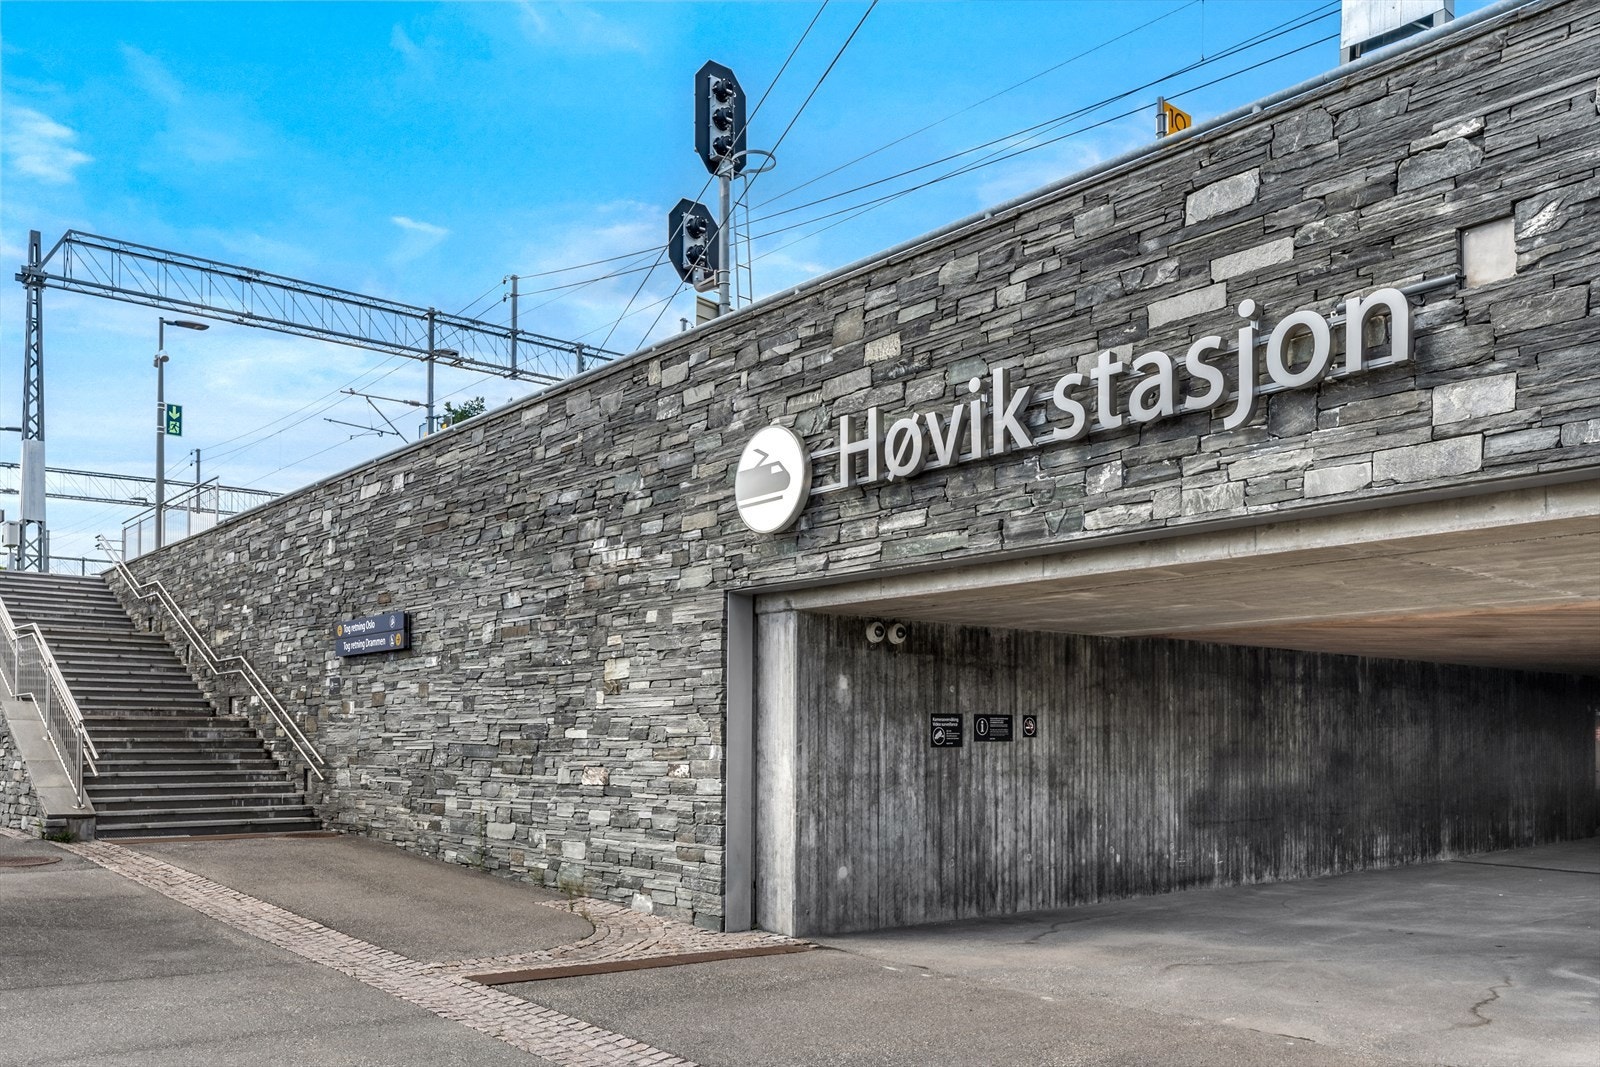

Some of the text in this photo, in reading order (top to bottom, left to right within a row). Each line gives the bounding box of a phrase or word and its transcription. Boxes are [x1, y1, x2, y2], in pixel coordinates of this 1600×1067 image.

[1169, 108, 1187, 131] 10
[840, 288, 1410, 488] Høvik stasjon
[343, 624, 351, 634] Tog
[365, 620, 376, 630] Oslo
[343, 641, 351, 652] Tog
[365, 637, 386, 648] Drammen
